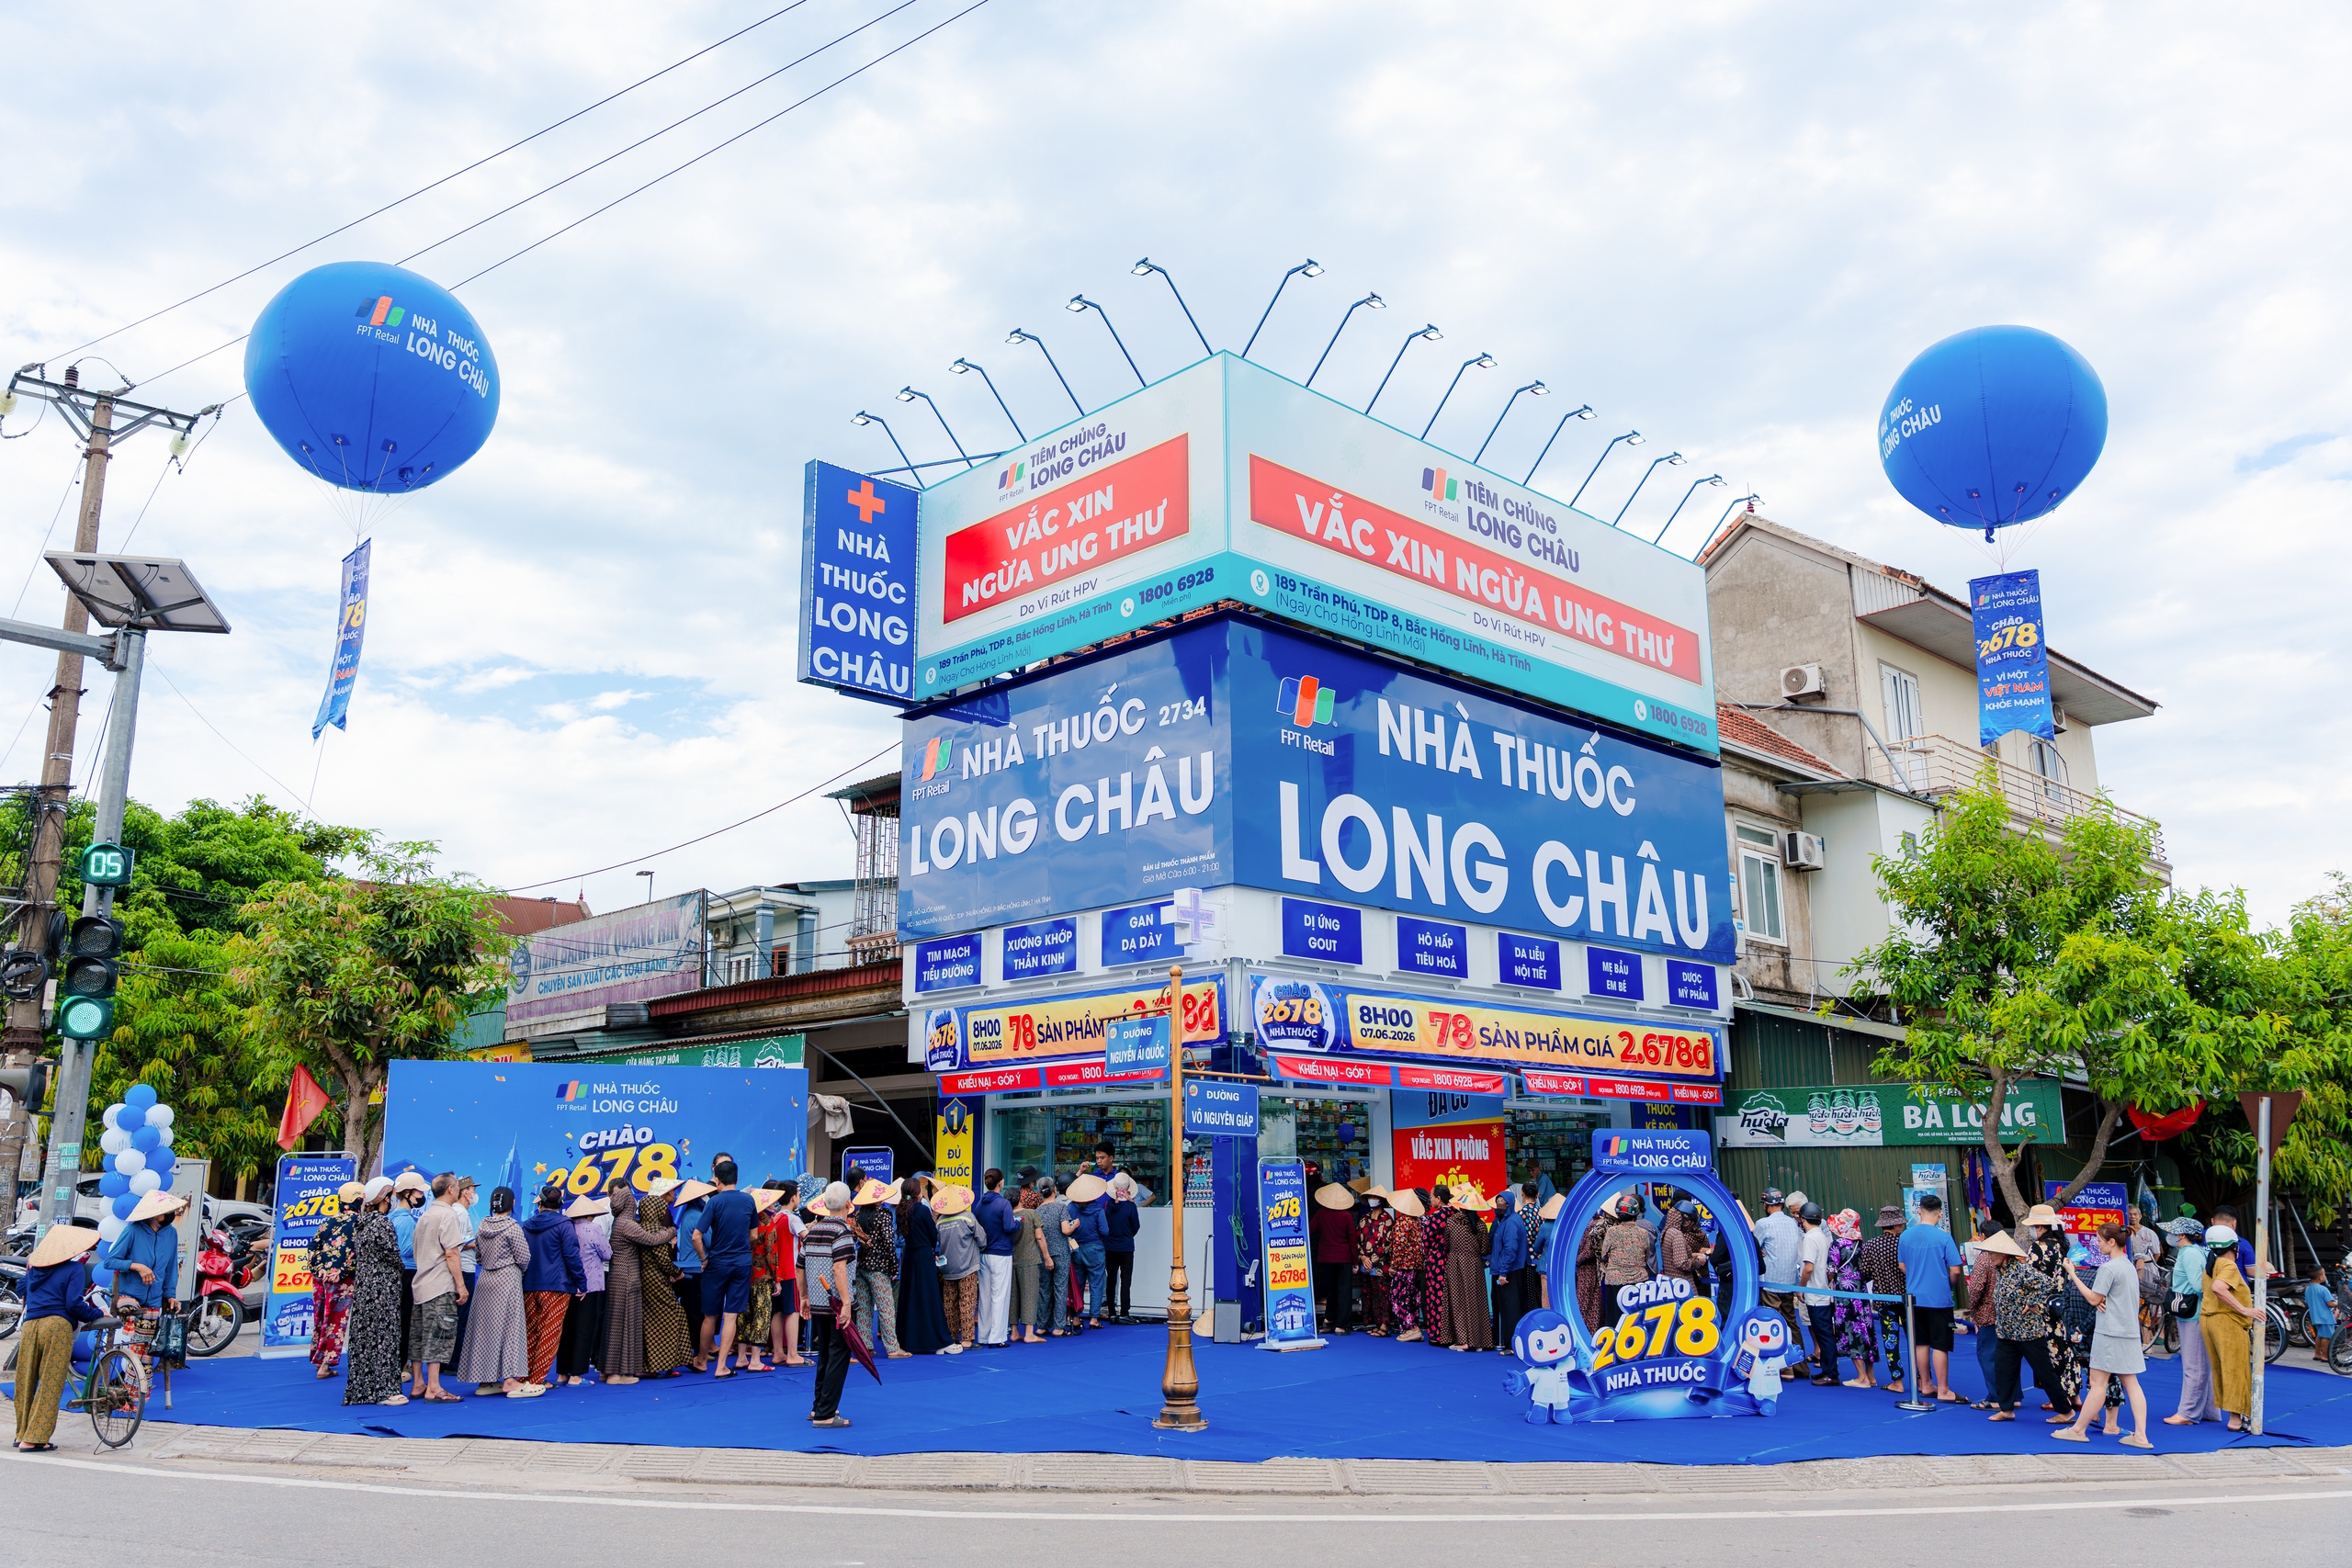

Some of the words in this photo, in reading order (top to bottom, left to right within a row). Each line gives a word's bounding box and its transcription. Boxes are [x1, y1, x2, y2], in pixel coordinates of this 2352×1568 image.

[412, 313, 437, 338] NHÀ
[447, 330, 480, 363] THUỐC
[406, 333, 457, 370] LONG
[458, 360, 489, 398] CHÂU
[1883, 427, 1900, 458] LONG
[1902, 404, 1941, 438] CHÂU
[1030, 445, 1057, 468] TIÊM
[1059, 423, 1107, 457] CHỦNG
[1030, 457, 1074, 491] LONG
[1078, 432, 1126, 471] CHÂU
[1005, 505, 1058, 551] VẮC
[1066, 485, 1114, 527] XIN
[1464, 479, 1500, 512] TIÊM
[1503, 497, 1557, 536] CHỦNG
[838, 525, 891, 563] NHÀ
[1467, 505, 1522, 550] LONG
[1526, 531, 1579, 574] CHÂU
[962, 558, 1035, 607] NGỪA
[1040, 532, 1099, 577] UNG
[1105, 498, 1168, 550] THƯ
[820, 562, 907, 605] THUỐC
[1295, 493, 1375, 558] VẮC
[1385, 529, 1446, 584] XIN
[1457, 561, 1547, 618] NGỪA
[1554, 601, 1615, 647] UNG
[1620, 619, 1674, 668] THƯ
[1993, 599, 2014, 608] LONG
[2016, 594, 2039, 605] CHÂU
[2006, 588, 2028, 597] THUỐC
[815, 596, 909, 646] LONG
[1274, 573, 1296, 593] 189
[1300, 578, 1329, 604] Trần
[1332, 590, 1361, 615] Phú,
[1363, 603, 1389, 624] TDP
[1391, 612, 1404, 630] 8,
[1406, 616, 1428, 639] Bắc
[1430, 625, 1460, 653] Hồng
[1463, 636, 1490, 662] Lĩnh,
[1492, 648, 1506, 664] Hà
[1508, 652, 1532, 672] Tĩnh
[1474, 612, 1487, 626] Do
[1490, 615, 1501, 631] Vi
[1504, 619, 1521, 638] Rút
[1524, 629, 1545, 648] HPV
[1991, 616, 2023, 631] CHÀO
[1979, 623, 2038, 659] 2678
[1985, 653, 2002, 665] NHÀ
[2003, 649, 2031, 660] THUỐC
[812, 647, 909, 694] CHÂU
[1996, 671, 2006, 681] VÌ
[2007, 670, 2029, 681] MỘT
[1984, 682, 2010, 697] VIỆT
[2014, 681, 2043, 693] NAM
[1985, 696, 2012, 710] KHỎE
[2014, 695, 2044, 708] MẠNH
[963, 722, 1025, 780] NHÀ
[1034, 682, 1147, 760] THUỐC
[1159, 696, 1206, 727] 2734
[1650, 704, 1678, 728] 1800
[1680, 716, 1708, 738] 6928
[1282, 729, 1301, 750] FPT
[1304, 738, 1334, 757] Retail
[1378, 700, 1482, 779] NHÀ
[1493, 731, 1636, 817] THUỐC
[910, 797, 1038, 876] LONG
[1055, 745, 1215, 842] CHÂU
[91, 852, 121, 876] 05
[1143, 863, 1153, 872] BÁN
[1161, 858, 1179, 868] THUỐC
[1181, 856, 1197, 864] THÀNH
[1199, 851, 1215, 861] PHẨM
[1280, 780, 1508, 914] LONG
[1532, 840, 1709, 950] CHÂU
[1143, 874, 1154, 883] Giờ
[1156, 872, 1166, 881] Mở
[1168, 870, 1182, 878] Cửa
[1183, 866, 1196, 875] 6:00
[1202, 863, 1219, 873] 21:00
[1129, 913, 1154, 928] GAN
[1304, 914, 1315, 932] DỊ
[1317, 913, 1340, 931] ỨNG
[1007, 935, 1042, 952] XƯƠNG
[1045, 931, 1072, 945] KHỚP
[1122, 937, 1137, 953] DẠ
[1139, 933, 1162, 949] DÀY
[1308, 937, 1337, 952] GOUT
[1418, 931, 1432, 947] HÔ
[1435, 932, 1453, 949] HẤP
[927, 952, 941, 962] TIM
[944, 945, 970, 962] MẠCH
[1013, 953, 1039, 970] THẦN
[1042, 953, 1065, 965] KINH
[1416, 951, 1436, 968] TIÊU
[1437, 953, 1457, 969] HOÁ
[1514, 946, 1527, 959] DA
[1529, 945, 1544, 962] LIỄU
[922, 966, 939, 982] TIỂU
[942, 964, 974, 979] ĐƯỜNG
[1515, 964, 1531, 979] NỘI
[1532, 963, 1547, 980] TIẾT
[1602, 961, 1613, 976] MẸ
[1615, 960, 1628, 976] BẦU
[1682, 970, 1702, 985] DƯỢC
[1274, 982, 1310, 998] CHÀO
[1606, 978, 1616, 991] EM
[1618, 976, 1627, 993] BÉ
[1679, 986, 1688, 999] MỸ
[1690, 985, 1709, 1001] PHẨM
[1261, 998, 1321, 1024] 2678
[1360, 1006, 1413, 1029] 8H00
[1124, 1027, 1152, 1040] ĐƯỜNG
[1270, 1026, 1285, 1038] NHÀ
[1286, 1024, 1317, 1039] THUỐC
[1361, 1028, 1415, 1043] 07.06.2026
[1429, 1011, 1476, 1050] 78
[1480, 1022, 1522, 1049] SẢN
[1526, 1027, 1579, 1055] PHẨM
[1584, 1032, 1614, 1058] GIÁ
[1619, 1031, 1711, 1069] 2.678đ
[1110, 1044, 1136, 1065] NGUYỄN
[1136, 1044, 1145, 1061] ÁI
[1145, 1040, 1164, 1059] QUỐC
[594, 1081, 617, 1094] NHÀ
[621, 1080, 660, 1094] THUỐC
[1206, 1089, 1239, 1101] ĐƯỜNG
[593, 1100, 634, 1113] LONG
[639, 1097, 678, 1113] CHÂU
[1904, 1100, 1944, 1128] BÀ
[1191, 1108, 1204, 1125] VÕ
[1204, 1111, 1235, 1126] NGUYÊN
[1237, 1111, 1253, 1127] GIÁP
[1740, 1109, 1789, 1127] huda
[579, 1123, 652, 1149] CHÀO
[1411, 1131, 1433, 1160] VẮC
[1434, 1138, 1453, 1160] XIN
[1454, 1134, 1489, 1160] PHÒNG
[1633, 1138, 1654, 1149] NHÀ
[1656, 1135, 1690, 1149] THUỐC
[947, 1145, 960, 1159] ĐỦ
[1634, 1155, 1668, 1168] LONG
[1672, 1153, 1706, 1168] CHÂU
[546, 1144, 677, 1195] 2678
[938, 1162, 969, 1177] THUỐC
[1622, 1275, 1690, 1306] CHÀO
[1593, 1297, 1720, 1371] 2678
[1607, 1367, 1642, 1391] NHÀ
[1645, 1361, 1706, 1385] THUỐC
